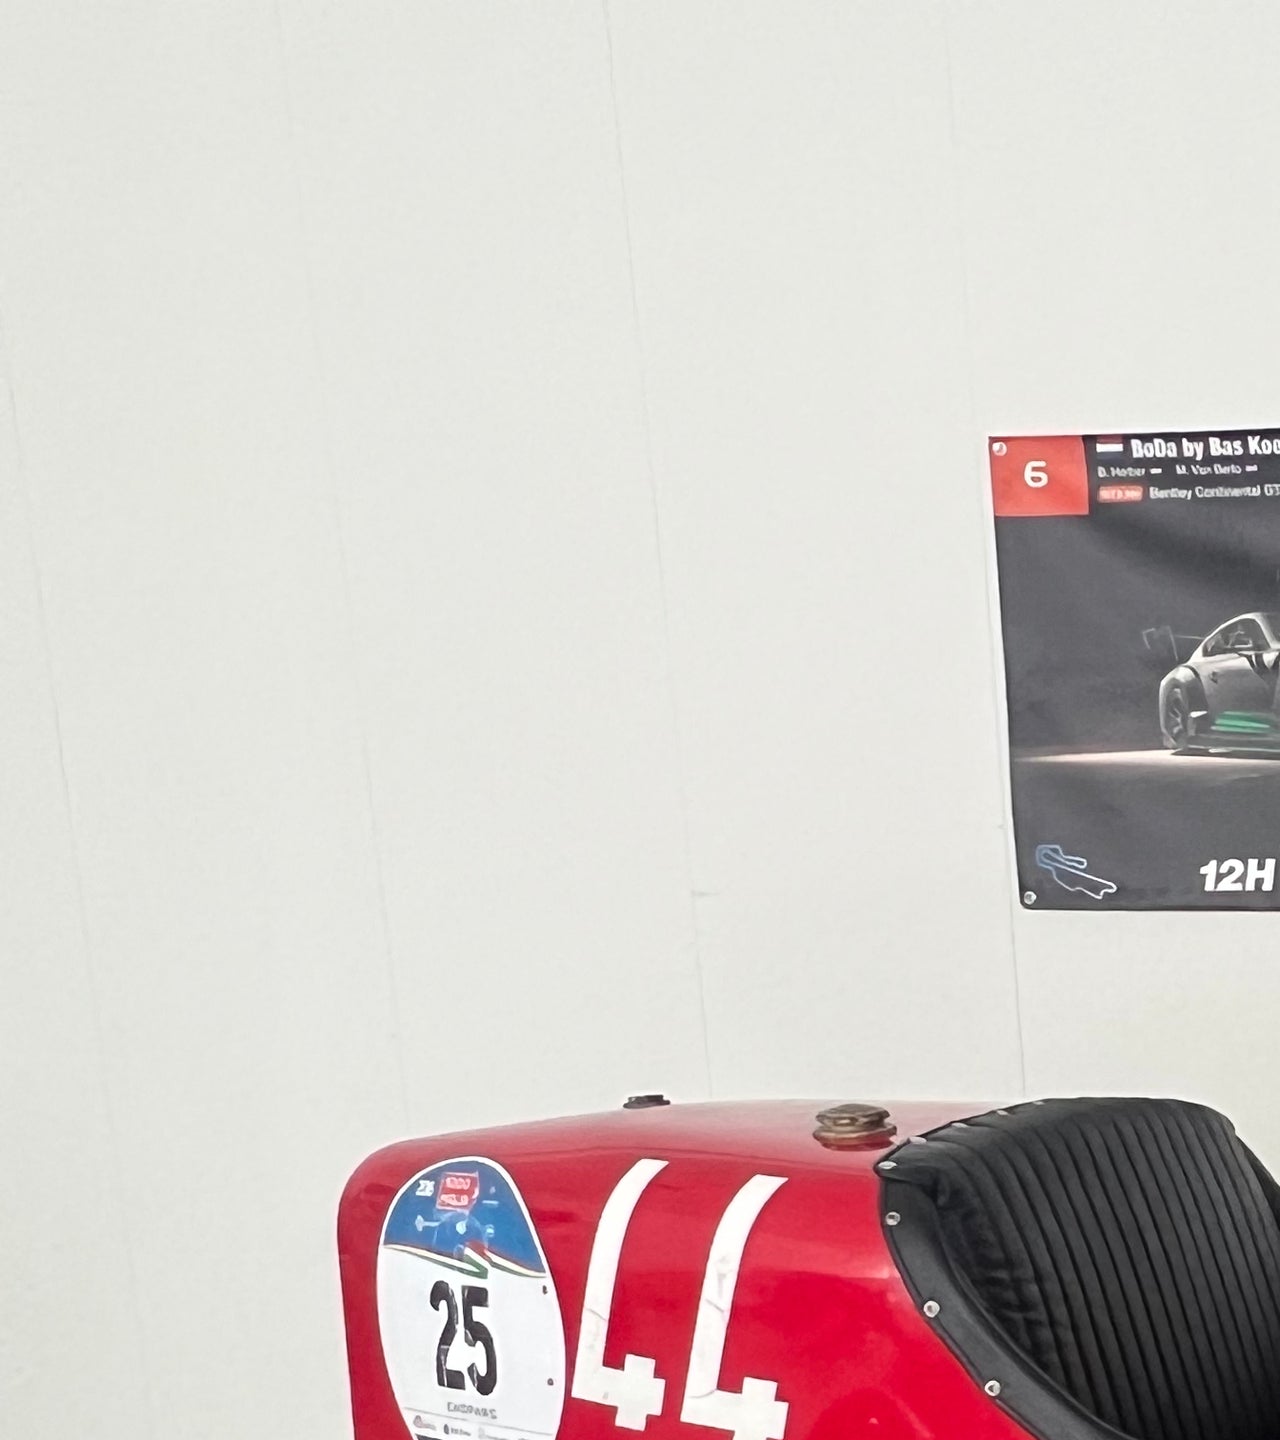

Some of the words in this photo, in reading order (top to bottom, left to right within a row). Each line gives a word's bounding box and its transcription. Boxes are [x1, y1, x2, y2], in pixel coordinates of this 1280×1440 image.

[1130, 438, 1178, 459] BoDa
[1181, 437, 1204, 461] by
[1208, 436, 1244, 457] Bas
[1023, 460, 1049, 489] 6
[1199, 858, 1276, 892] 12H
[429, 1279, 498, 1397] 25
